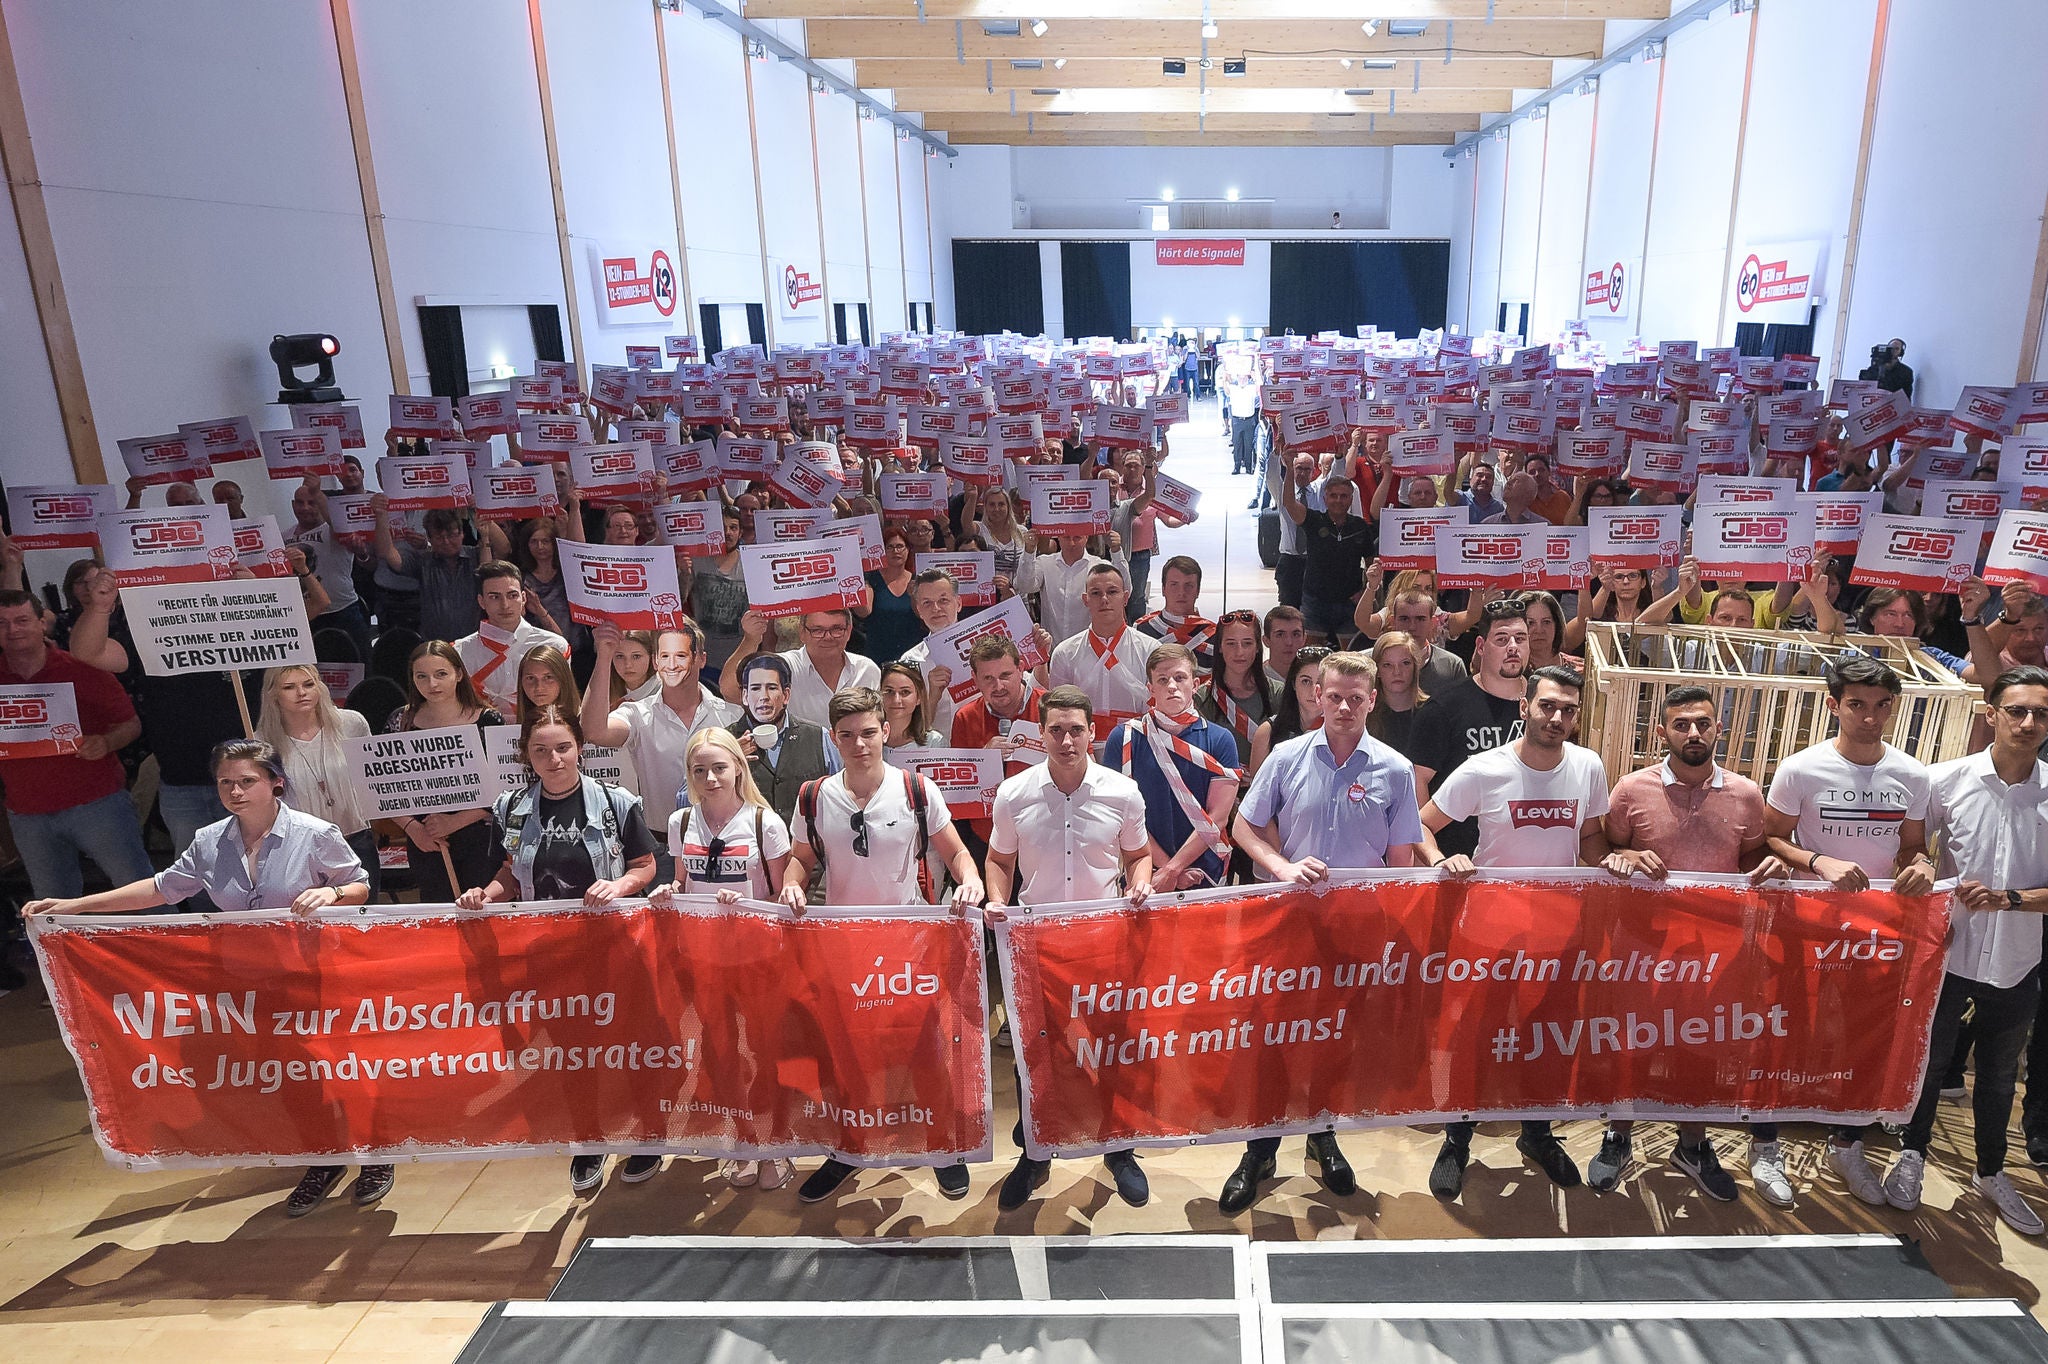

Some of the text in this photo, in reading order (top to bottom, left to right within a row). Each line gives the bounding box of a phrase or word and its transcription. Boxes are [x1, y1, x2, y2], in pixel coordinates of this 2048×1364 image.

[1158, 247, 1243, 261] Hört die Signale!
[656, 268, 672, 297] 12
[1611, 276, 1622, 298] 12
[1741, 272, 1758, 296] 60
[801, 450, 829, 460] JBG
[596, 458, 634, 469] JBG
[406, 470, 444, 481] JBG
[495, 482, 533, 492] JBG
[39, 502, 90, 514] JBG
[1054, 495, 1088, 506] JBG
[1951, 497, 1999, 511] JBG
[119, 513, 211, 525] JUGENDVERTRAUENSRAT
[669, 517, 701, 529] JBG
[139, 528, 197, 543] JBG
[1614, 524, 1655, 535] JBG
[1729, 523, 1782, 538] JBG
[1468, 543, 1517, 555] JBG
[1896, 535, 1949, 553] JBG
[572, 553, 655, 563] JUGENDVERTRAUENSRAT
[760, 546, 843, 560] JUGENDVERTRAUENSRAT
[588, 568, 641, 585] JBG
[780, 560, 830, 577] JBG
[1853, 574, 1901, 587] #JVRbleibt
[201, 593, 218, 608] FÜR
[221, 592, 278, 607] JUGENDLICHE
[149, 613, 187, 628] WURDEN
[190, 611, 218, 624] STARK
[219, 630, 246, 643] DER
[250, 627, 299, 641] JUGEND
[409, 734, 465, 753] WURDE
[425, 775, 462, 791] WURDEN
[464, 773, 481, 786] DER
[378, 795, 411, 812] JUGEND
[1827, 789, 1904, 804] TOMMY
[683, 857, 748, 872] GIRISM
[1813, 921, 1904, 962] vida
[1811, 959, 1853, 973] jugend
[850, 955, 941, 997] vida
[1071, 950, 1720, 1019] Hände falten und Goschn halten!
[854, 996, 894, 1011] jugend
[112, 990, 616, 1040] NEIN zur Abschaffung
[1075, 1008, 1346, 1069] Nicht mit uns!
[1490, 1003, 1789, 1063] #JVRbleibt
[131, 1037, 697, 1094] des Jugendvertrauensrates!
[1766, 1067, 1853, 1086] vidajugend
[672, 1101, 754, 1121] vidajugend
[803, 1100, 935, 1129] #JVRbleibt
